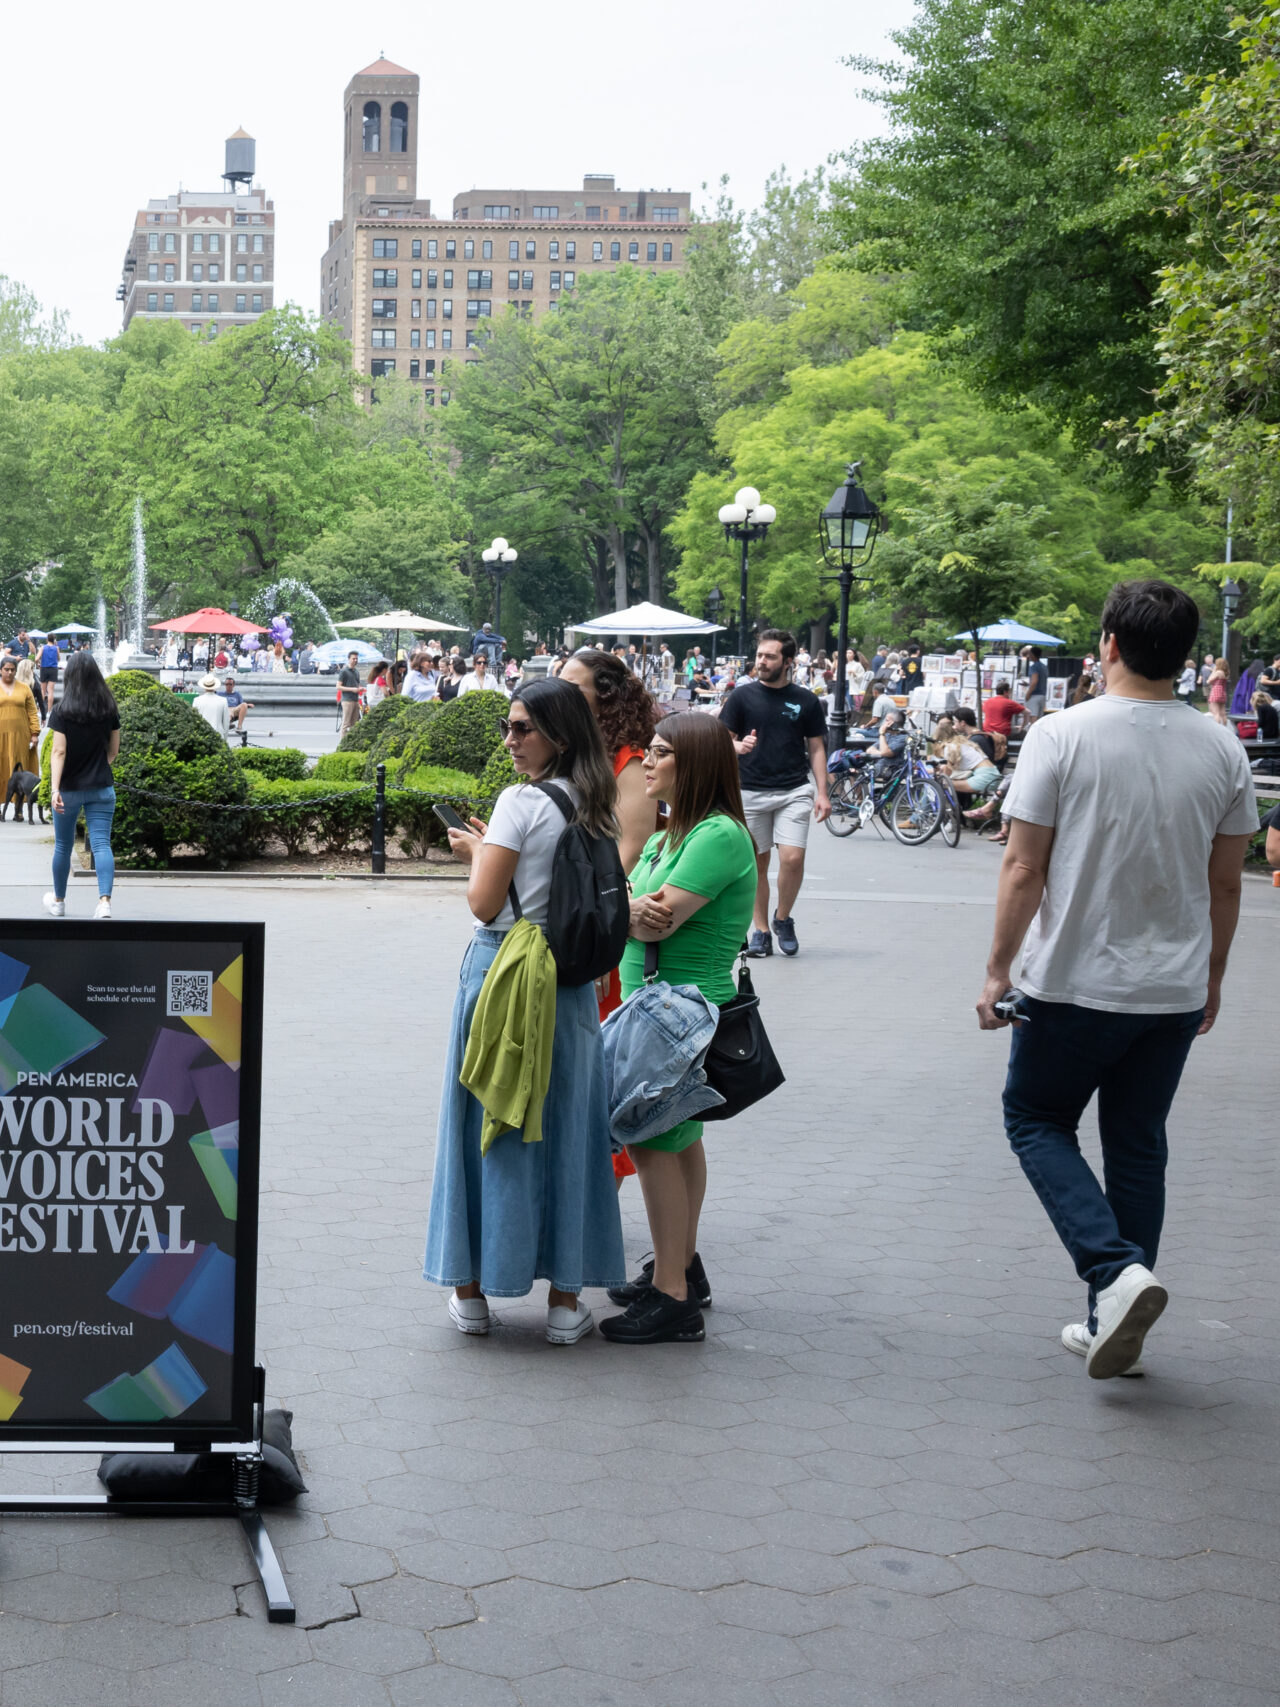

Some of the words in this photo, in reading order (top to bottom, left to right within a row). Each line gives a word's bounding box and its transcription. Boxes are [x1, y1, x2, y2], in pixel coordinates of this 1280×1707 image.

[87, 984, 106, 993] Scan
[107, 985, 115, 993] to
[130, 985, 142, 993] the
[143, 985, 156, 993] full
[87, 994, 119, 1003] schedule
[121, 994, 131, 1003] of
[17, 1071, 52, 1086] PEN
[56, 1072, 138, 1088] AMERICA
[13, 1320, 134, 1338] pen.org/festival
